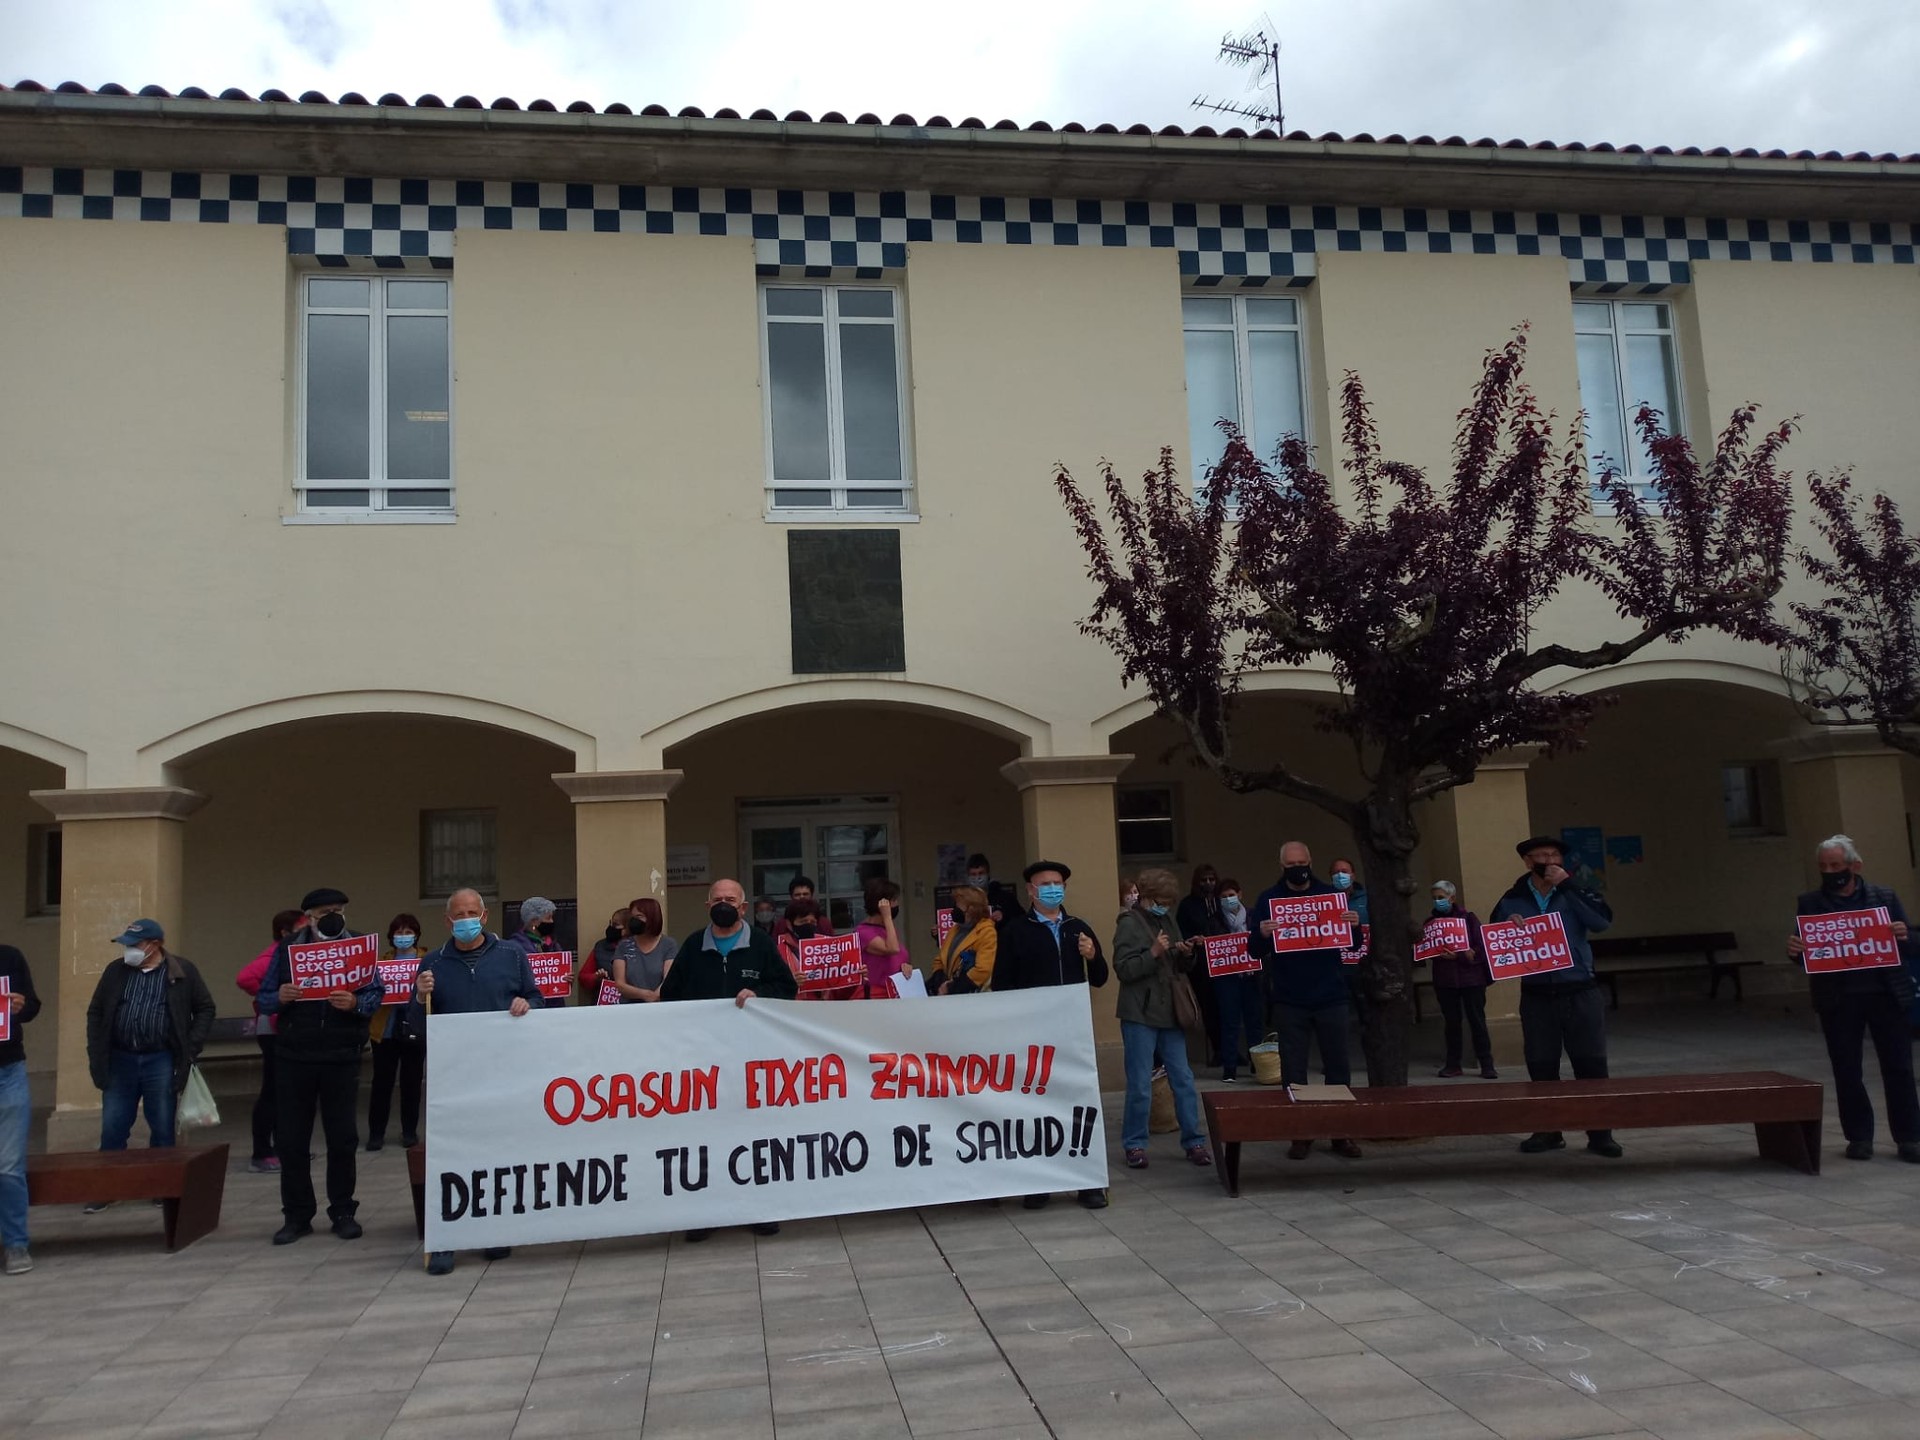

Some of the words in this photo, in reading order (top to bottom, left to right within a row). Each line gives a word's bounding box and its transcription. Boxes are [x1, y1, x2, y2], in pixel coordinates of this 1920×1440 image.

[1274, 900, 1333, 914] osasun
[1276, 913, 1317, 924] etxea
[1803, 916, 1874, 933] osasun
[1277, 920, 1347, 940] zaindu
[1487, 922, 1547, 940] osasun
[1805, 930, 1855, 943] etxea
[804, 941, 852, 955] osasun
[1208, 936, 1248, 949] osasun
[1416, 933, 1465, 953] zaindu
[1489, 936, 1533, 951] etxea
[1807, 938, 1893, 960] zaindu
[294, 943, 362, 962] osasun
[1209, 946, 1238, 956] etxea
[1491, 942, 1566, 967] zaindu
[296, 960, 345, 973] etxea
[804, 954, 840, 966] etxea
[297, 965, 374, 989] zaindu
[380, 972, 410, 981] txea
[532, 966, 559, 974] entro
[804, 961, 860, 980] zaindu
[543, 1065, 719, 1126] OSASUN
[745, 1053, 847, 1109] ETXEA
[869, 1045, 1056, 1100] ZAINDU!!
[440, 1154, 628, 1222] DEFIENDE
[655, 1145, 709, 1196] TU
[728, 1130, 869, 1185] CENTRO
[893, 1124, 932, 1168] DE
[956, 1106, 1098, 1163] SALUD!!
